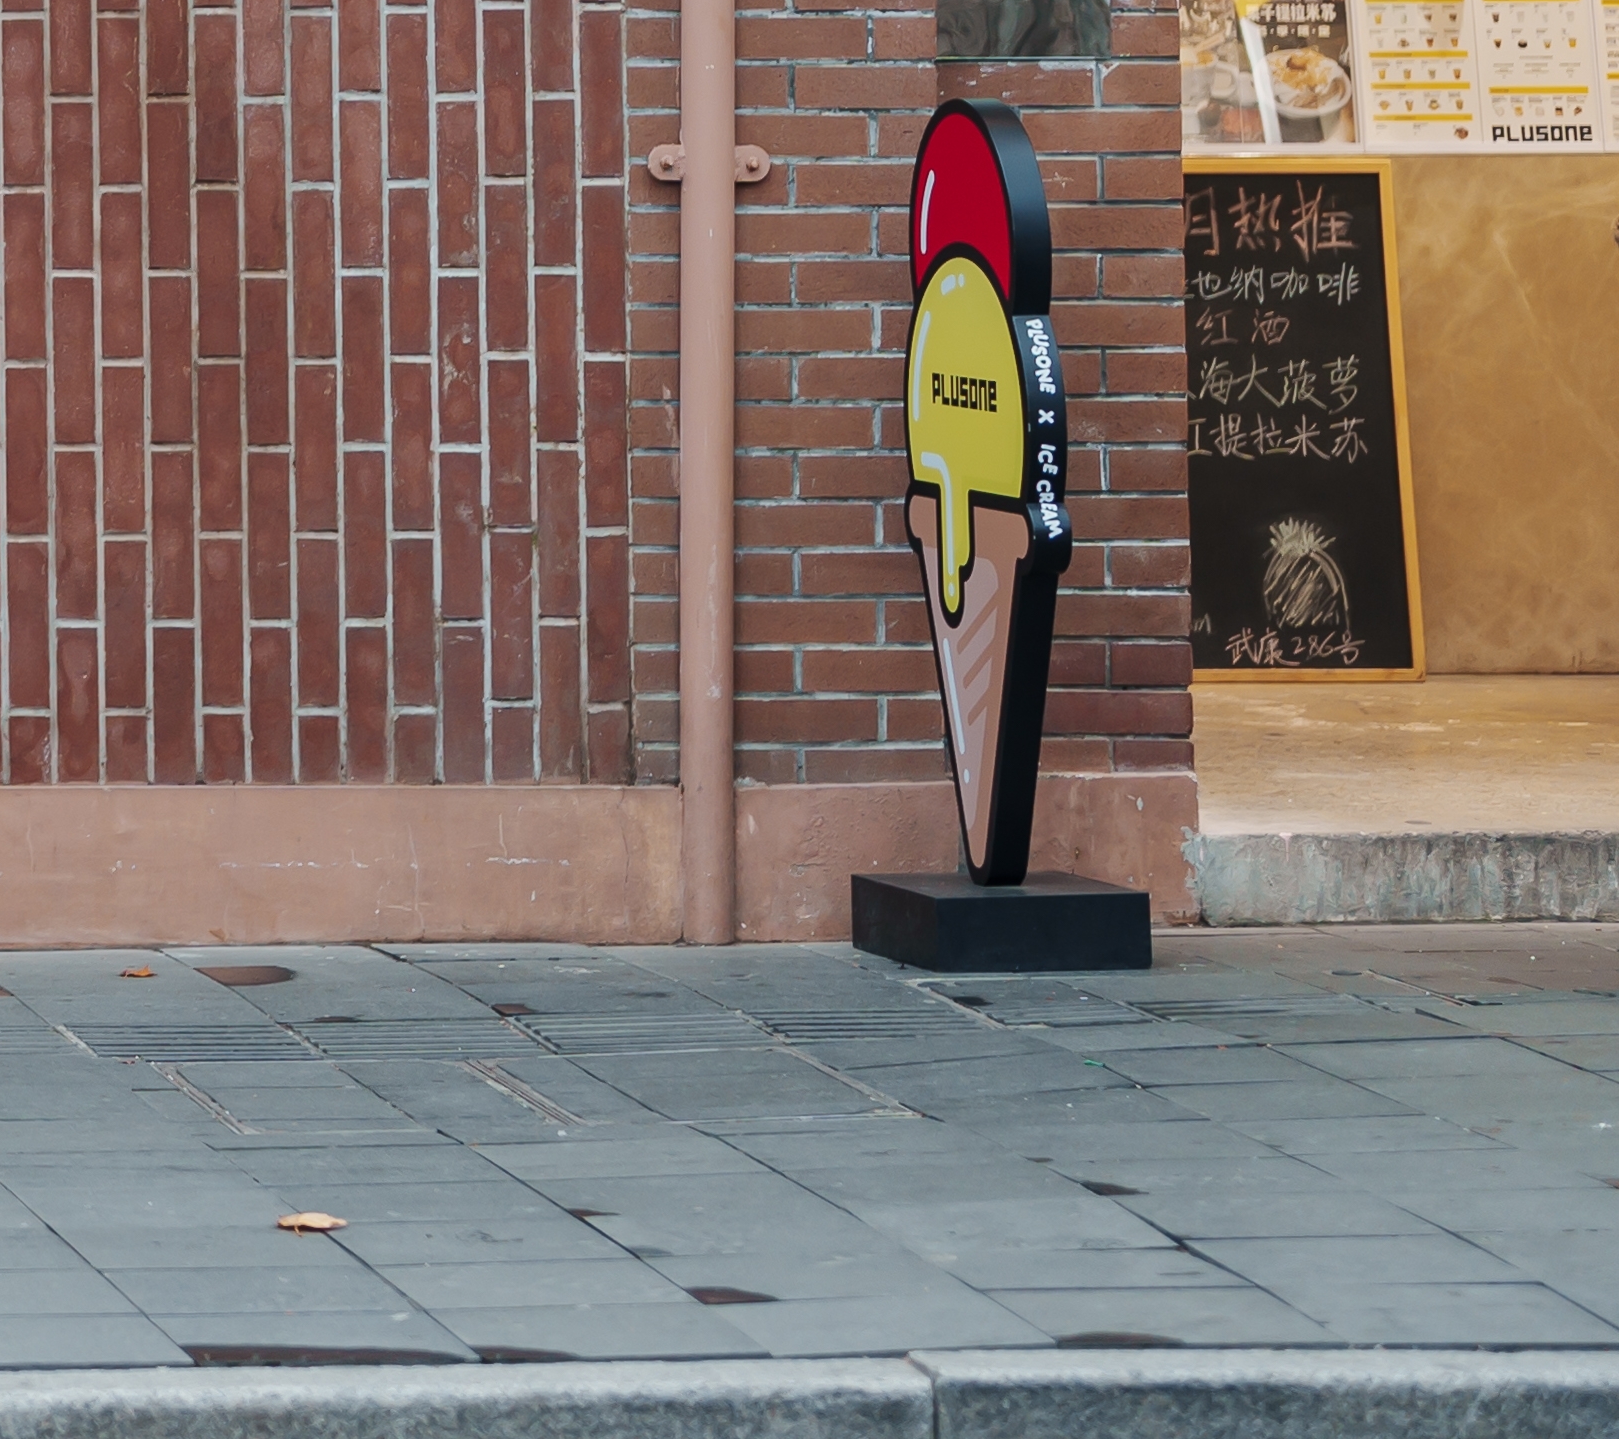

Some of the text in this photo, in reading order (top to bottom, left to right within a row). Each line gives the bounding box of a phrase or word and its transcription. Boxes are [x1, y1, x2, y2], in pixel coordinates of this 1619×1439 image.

[1184, 261, 1361, 306] 也纳咖啡
[1025, 317, 1056, 396] PLUSONE
[1186, 353, 1360, 415] 海大菠萝
[1037, 443, 1059, 475] ICE
[1036, 479, 1063, 539] CREAM
